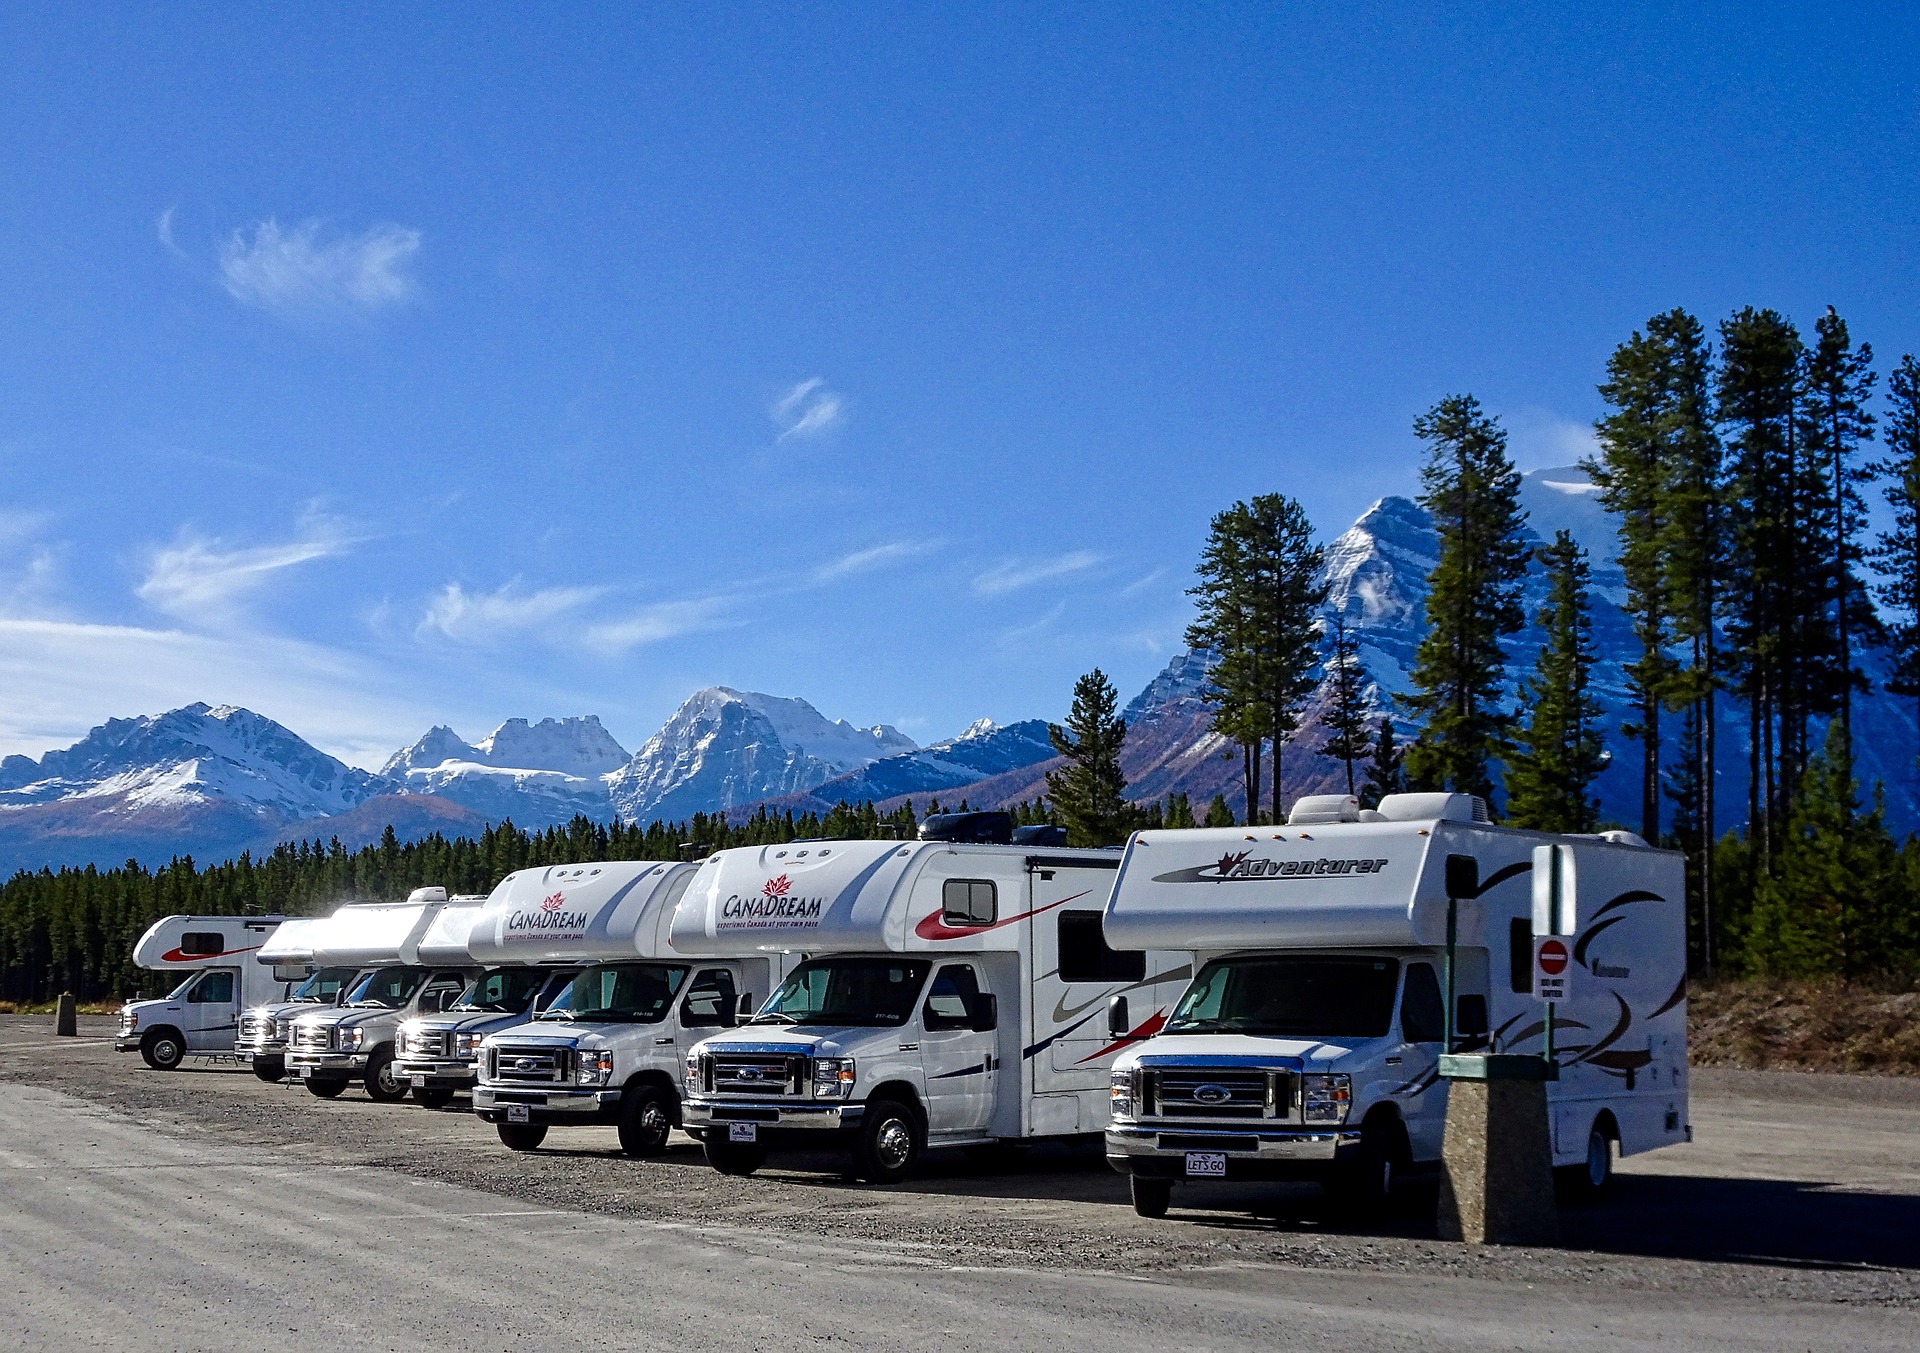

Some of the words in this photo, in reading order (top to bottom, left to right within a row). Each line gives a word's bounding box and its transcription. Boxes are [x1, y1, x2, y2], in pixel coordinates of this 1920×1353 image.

[1231, 858, 1389, 877] Adventurer
[722, 895, 822, 917] CANADREAM
[508, 910, 588, 930] CANADREAM
[716, 921, 747, 929] experience
[747, 920, 767, 928] Canada
[768, 920, 775, 928] at
[1188, 1161, 1209, 1171] LET'S
[1210, 1161, 1225, 1171] GO
